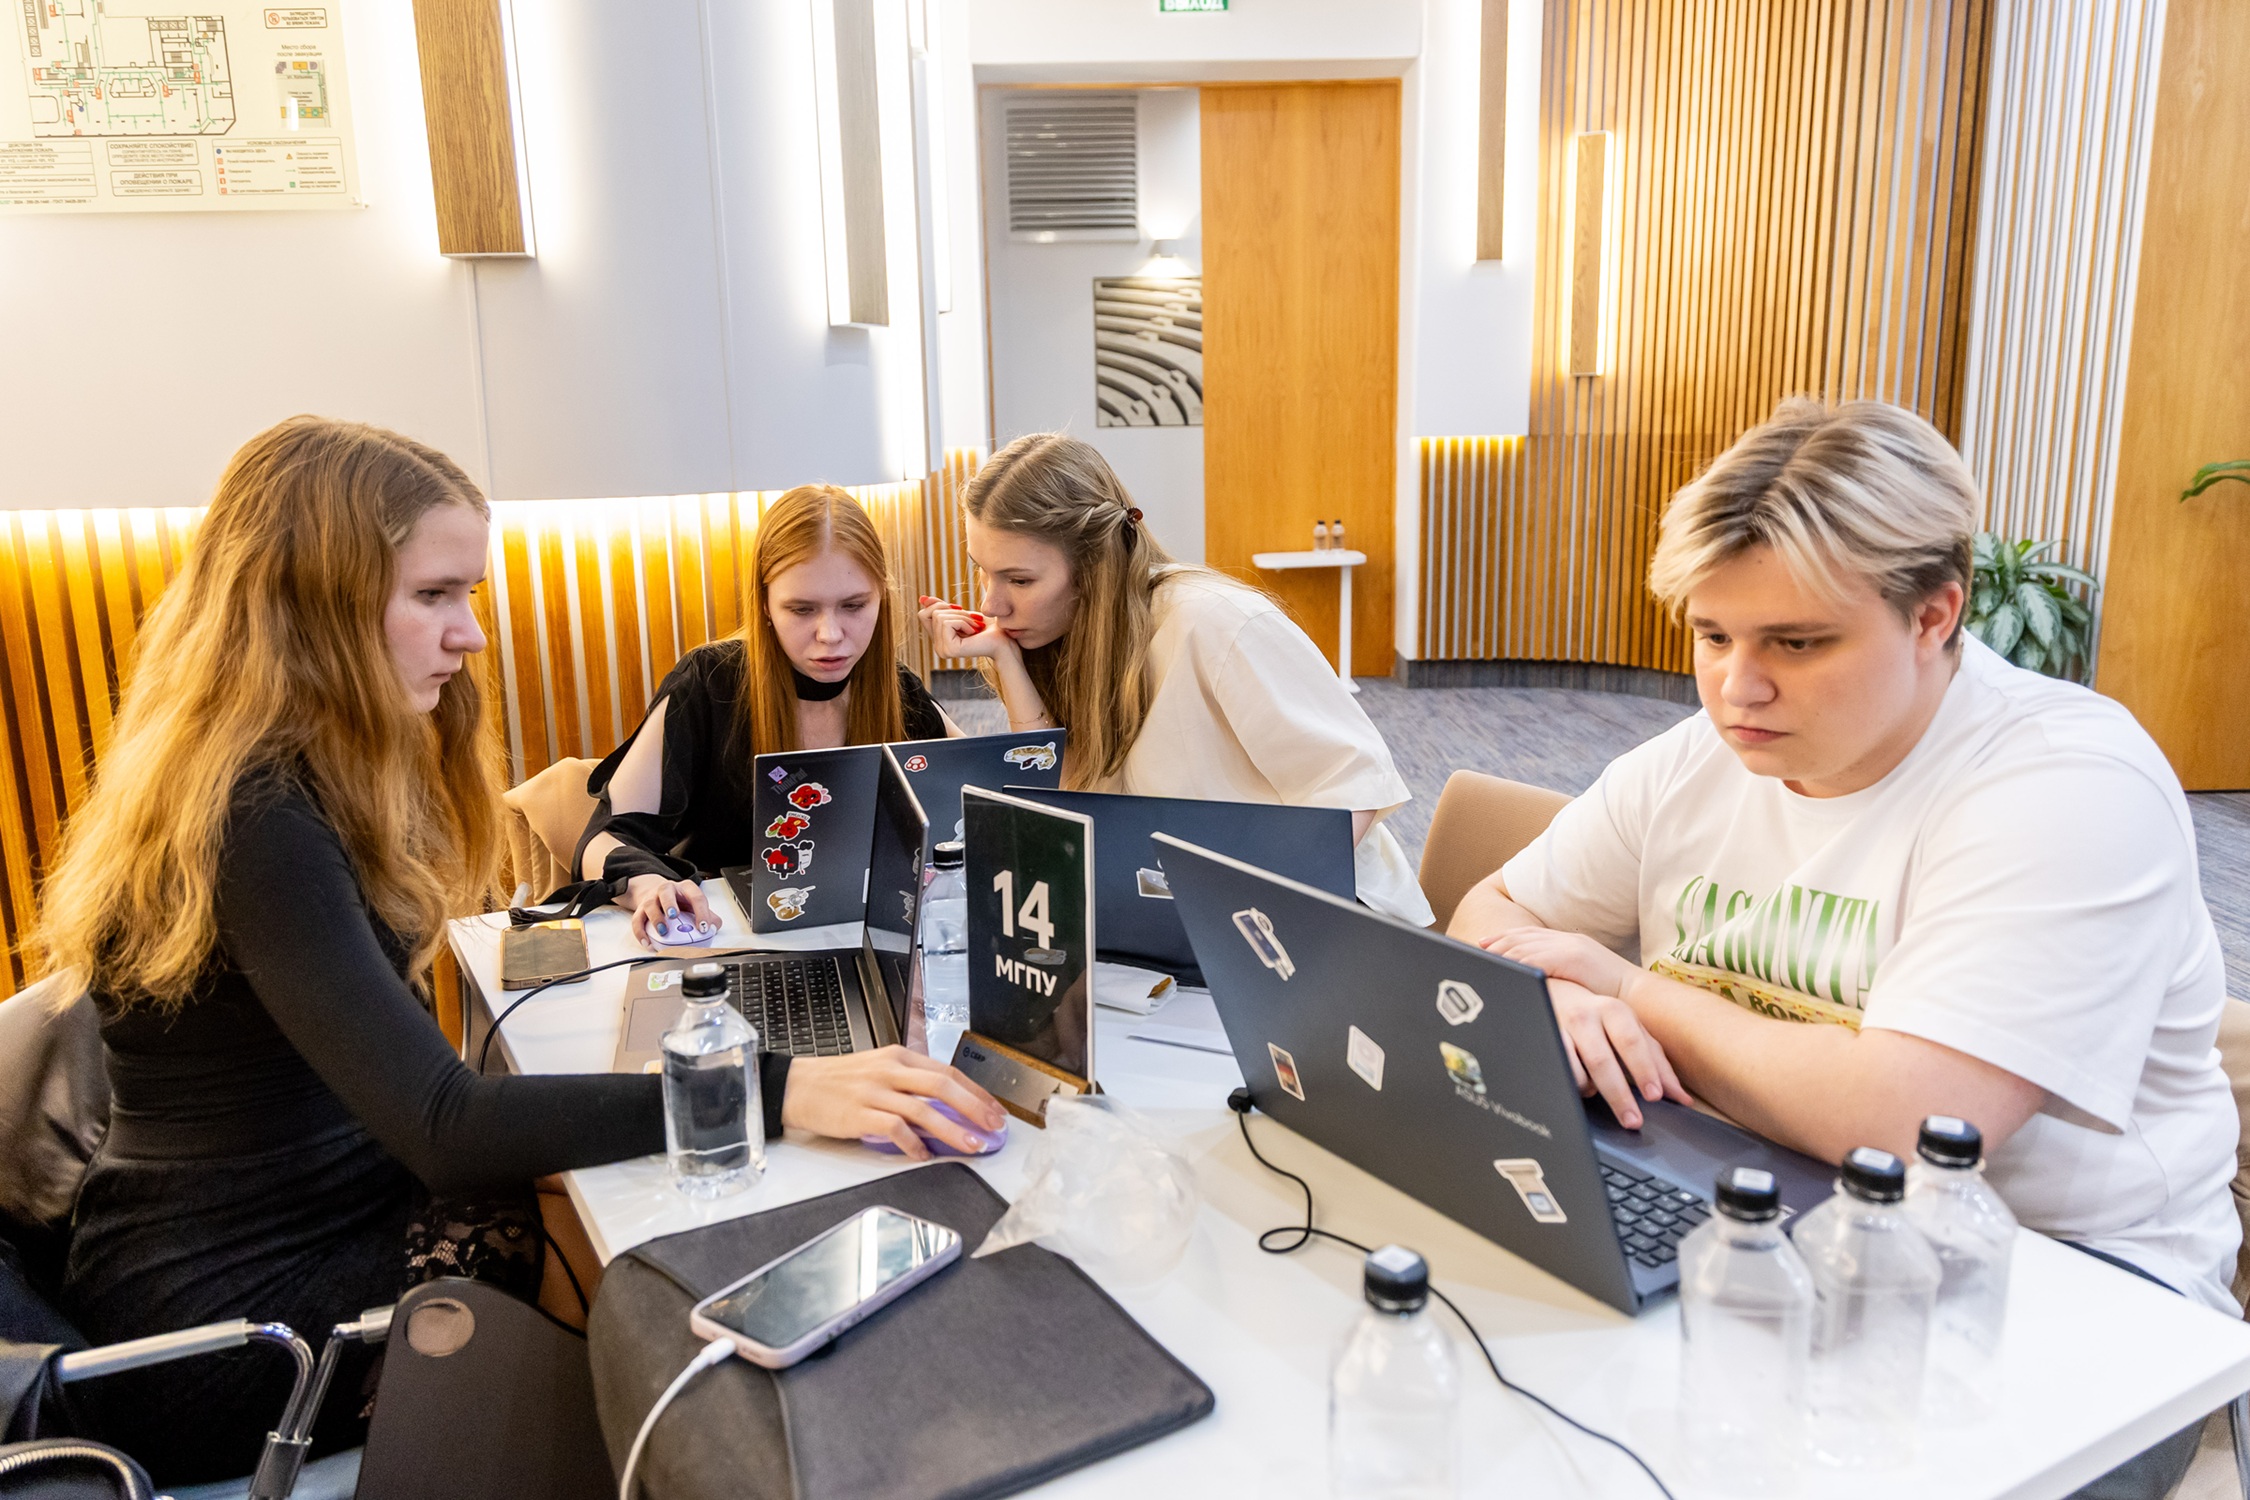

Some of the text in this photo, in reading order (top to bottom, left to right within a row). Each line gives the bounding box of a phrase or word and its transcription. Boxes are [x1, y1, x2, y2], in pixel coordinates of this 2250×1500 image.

[992, 869, 1055, 951] 14
[995, 954, 1058, 997] МГПУ
[1489, 1101, 1554, 1139] Vivobook
